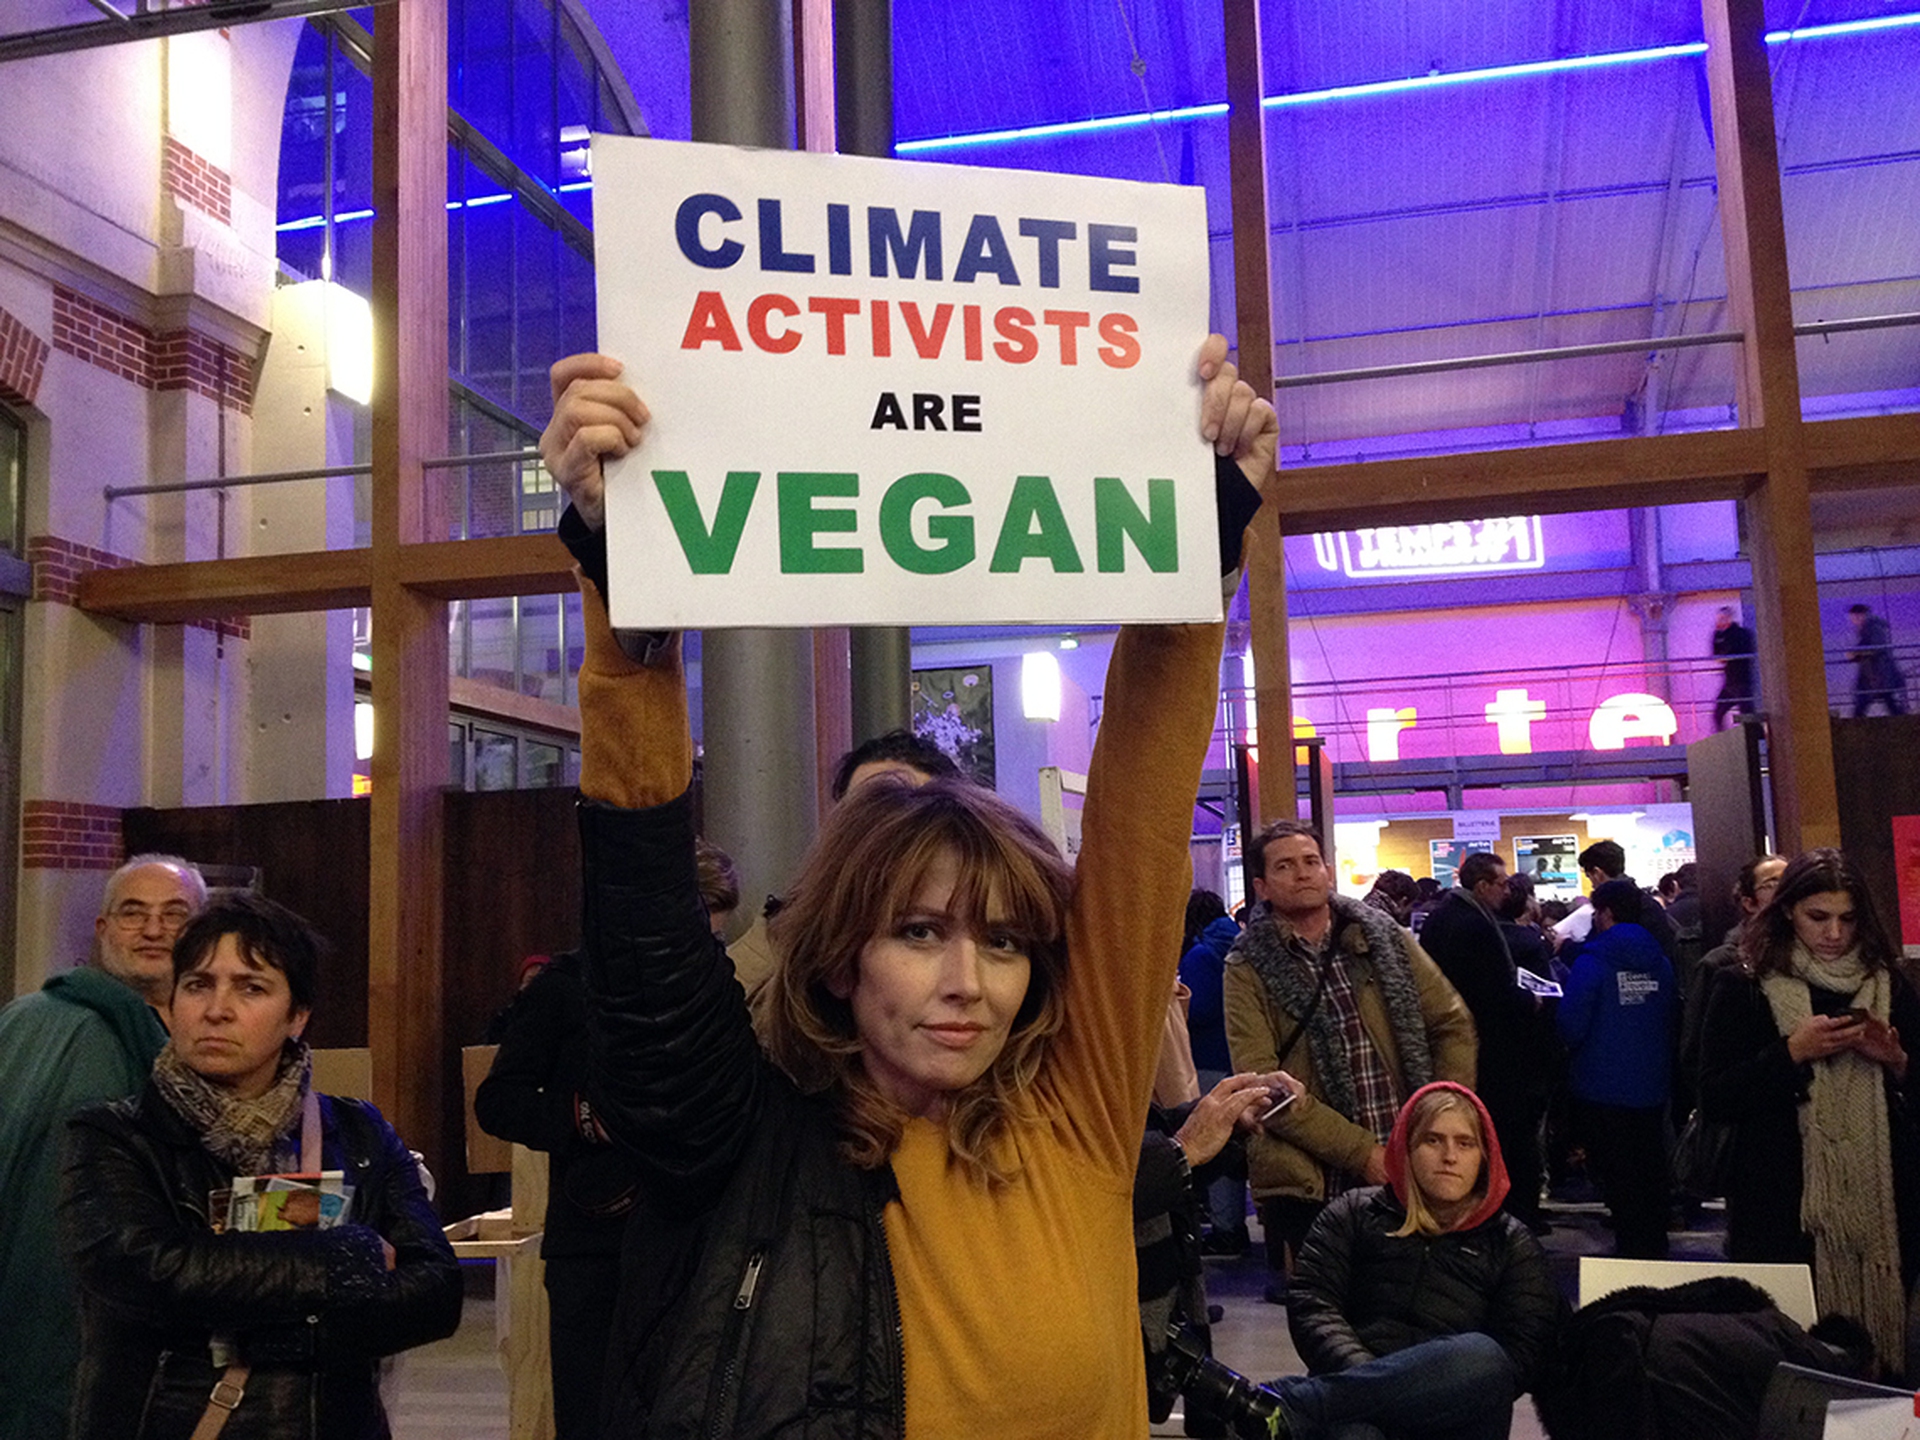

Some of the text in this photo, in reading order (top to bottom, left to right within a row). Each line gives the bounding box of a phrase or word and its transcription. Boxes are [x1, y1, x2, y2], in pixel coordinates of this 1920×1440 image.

[674, 192, 1140, 294] CLIMATE
[680, 290, 1142, 369] ACTIVISTS
[870, 392, 982, 432] ARE
[651, 469, 1179, 575] VEGAN
